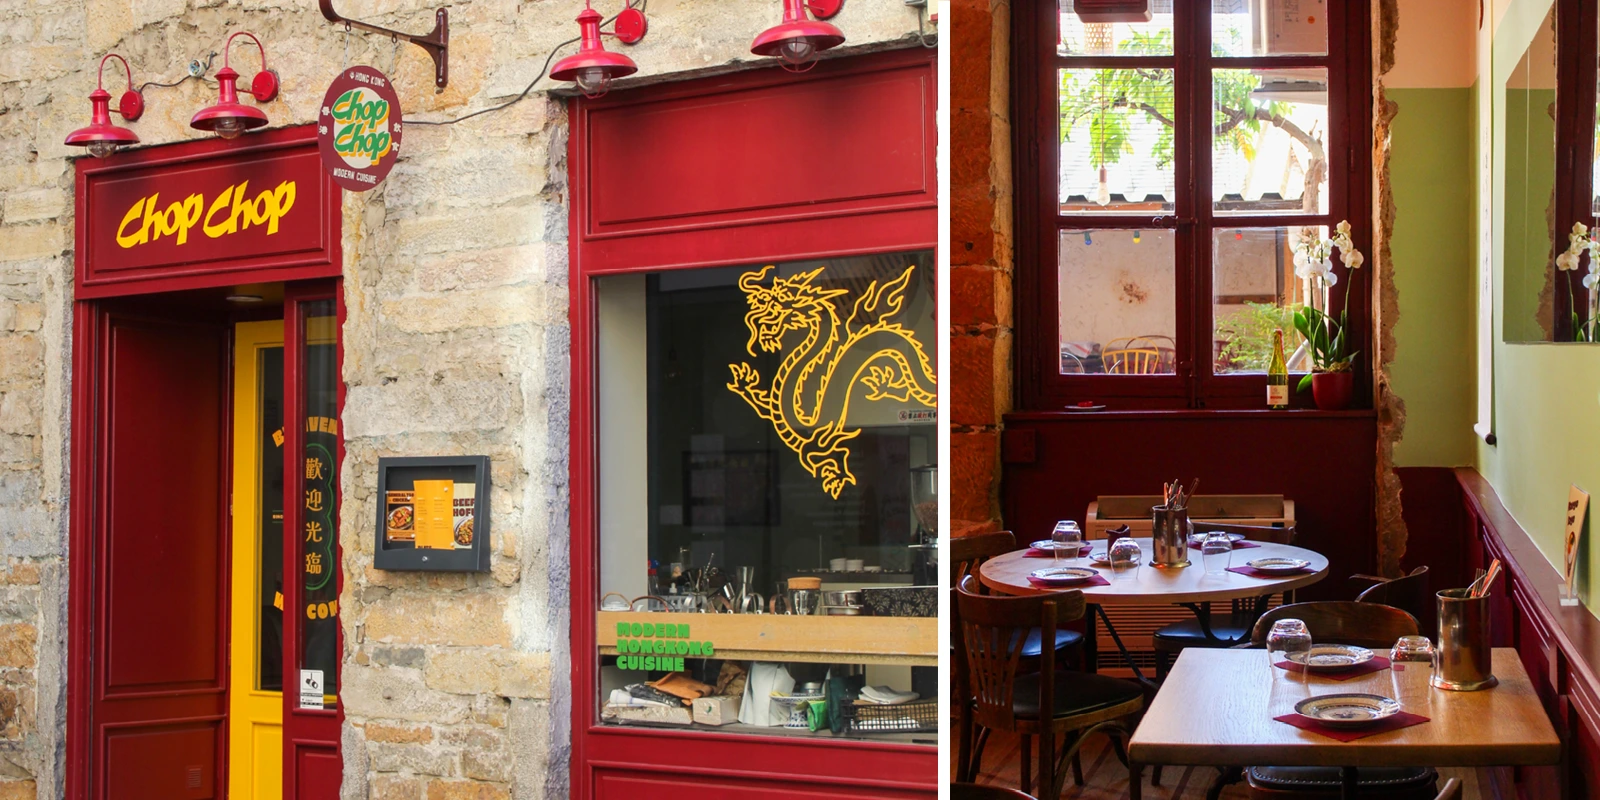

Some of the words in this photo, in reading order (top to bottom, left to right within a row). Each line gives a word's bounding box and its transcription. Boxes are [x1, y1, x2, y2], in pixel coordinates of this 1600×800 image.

[354, 72, 370, 84] HONG
[370, 76, 385, 88] KONG
[331, 90, 389, 131] Chop
[333, 123, 392, 165] Chop
[333, 167, 356, 180] MODERN
[356, 172, 377, 185] CUISINE
[116, 192, 204, 249] Chop
[202, 179, 297, 239] Chop
[616, 622, 690, 638] MODERN
[616, 639, 714, 656] HONGKONG
[616, 655, 685, 672] CUISINE
